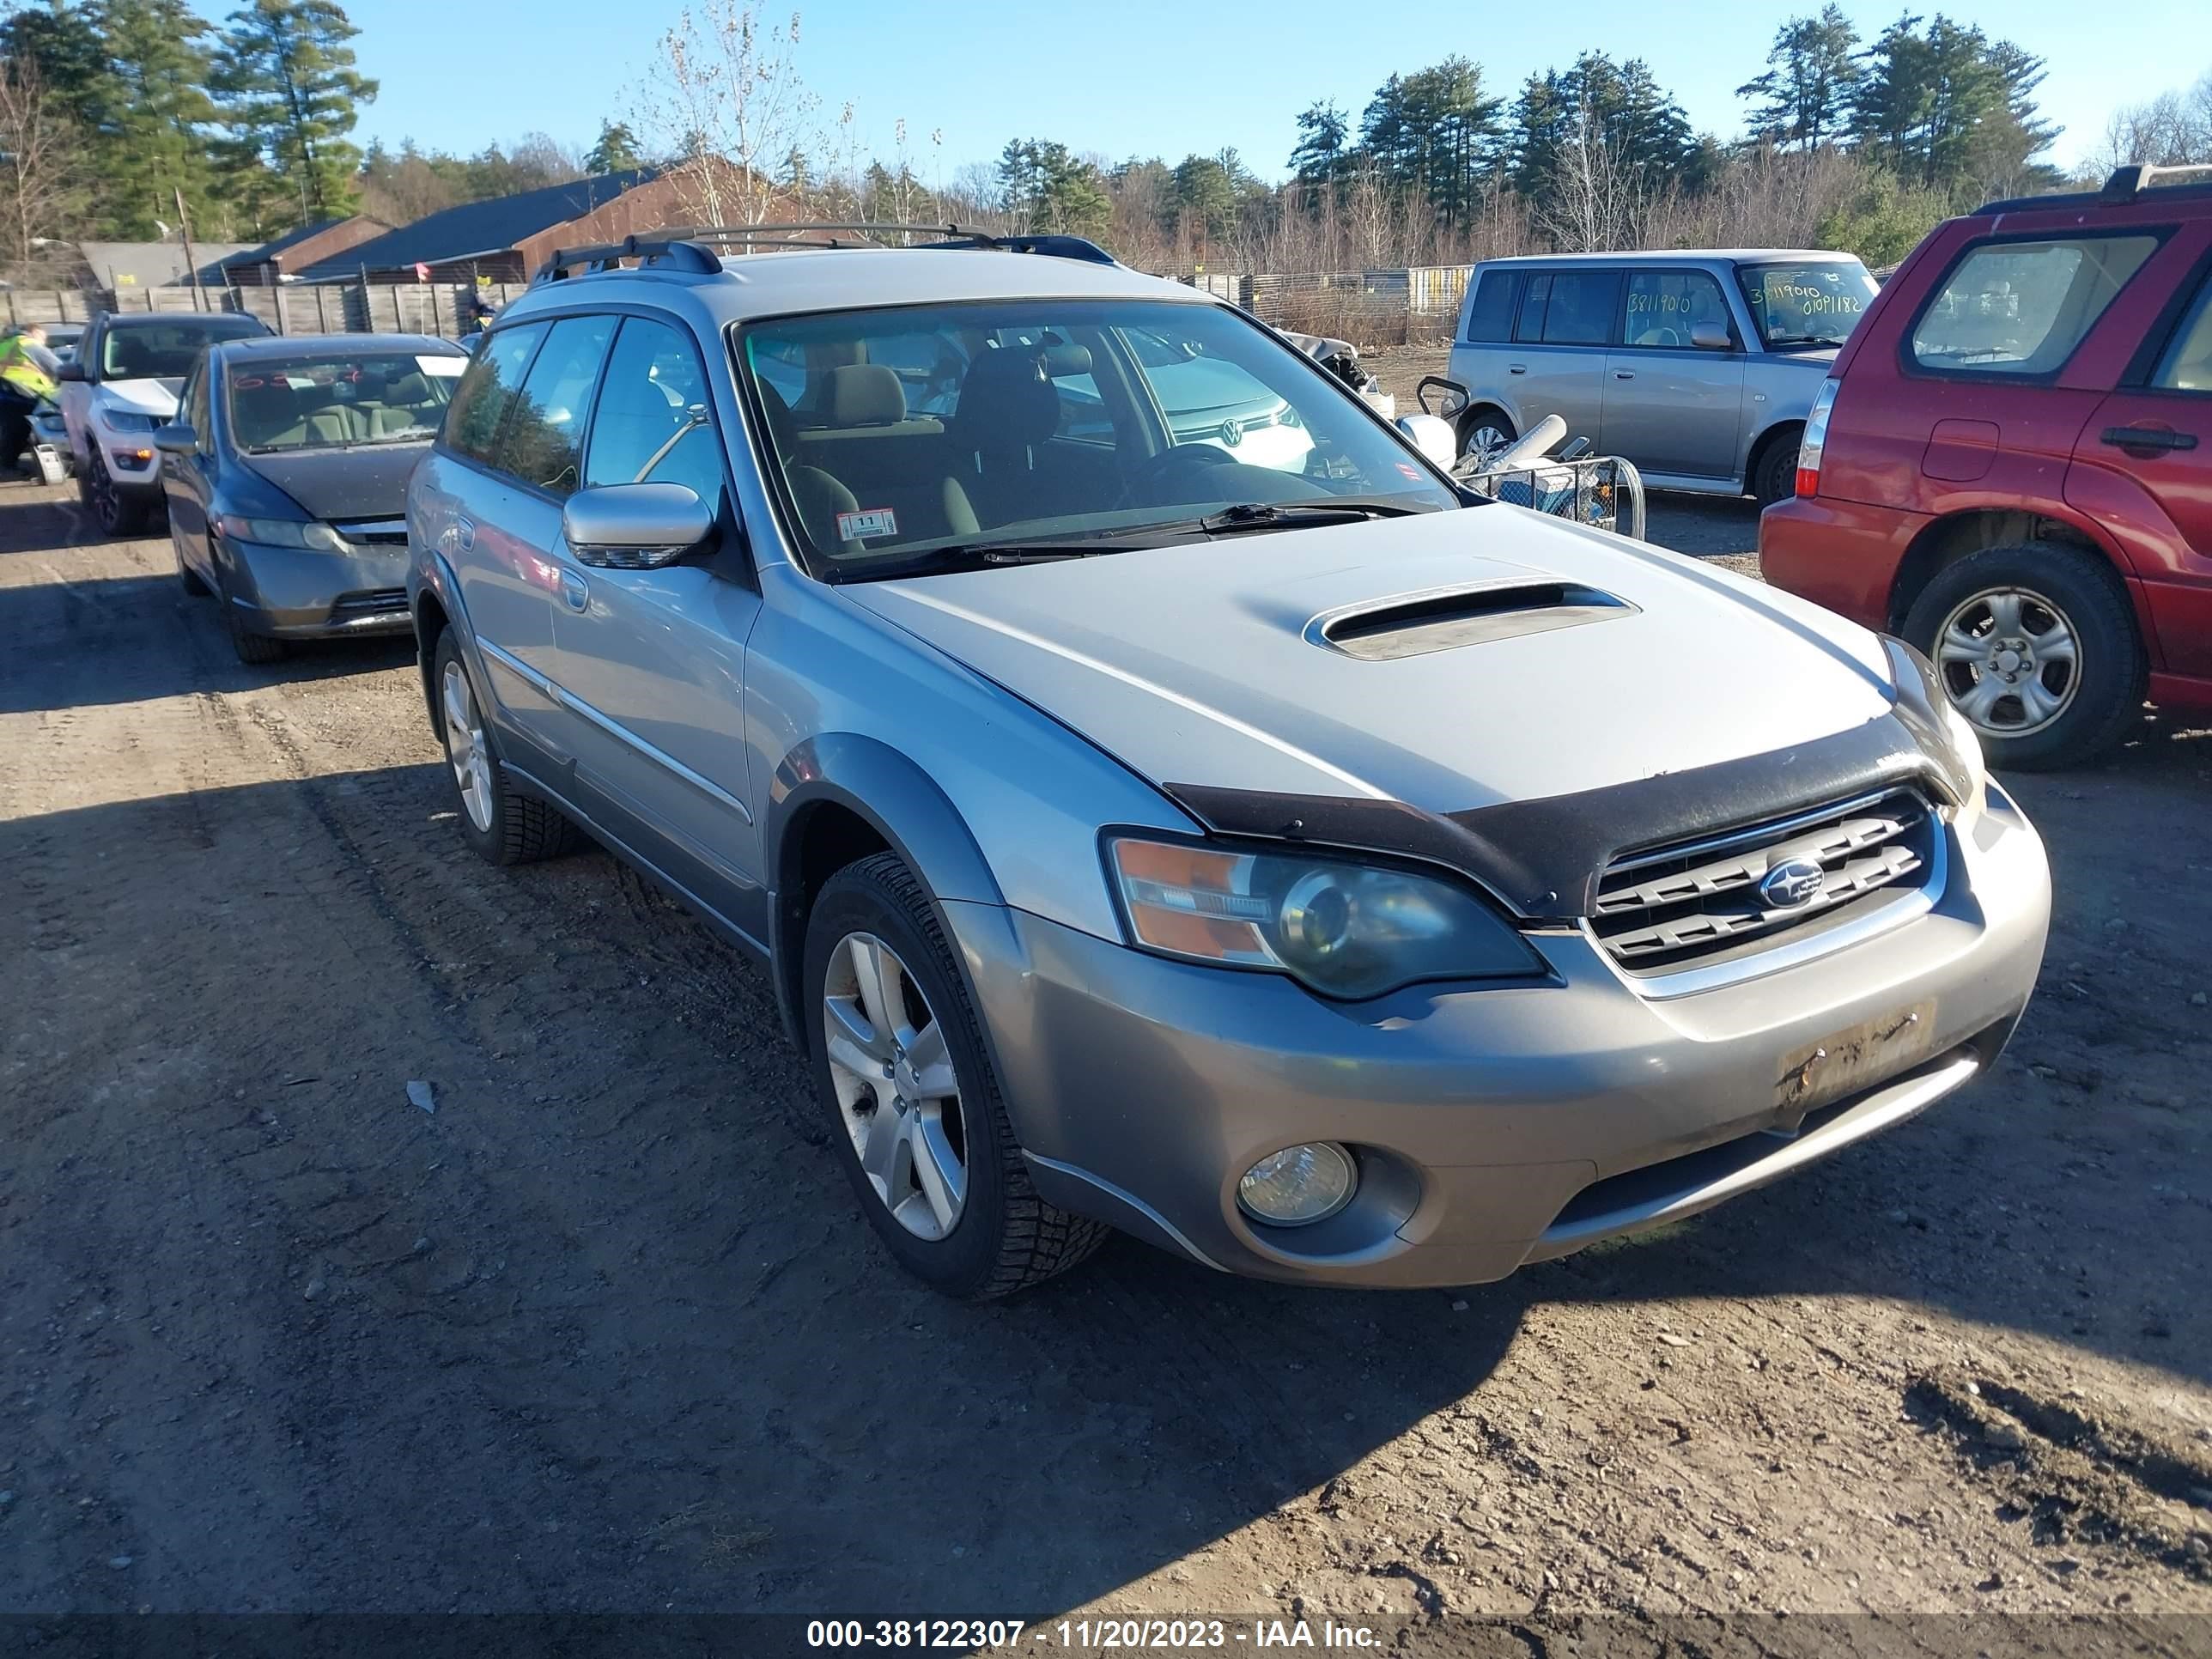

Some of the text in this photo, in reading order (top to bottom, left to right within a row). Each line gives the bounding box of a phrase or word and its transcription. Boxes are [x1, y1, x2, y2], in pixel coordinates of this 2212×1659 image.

[1628, 294, 1690, 313] 38119010
[1751, 285, 1820, 304] 38119010
[858, 517, 873, 526] 11
